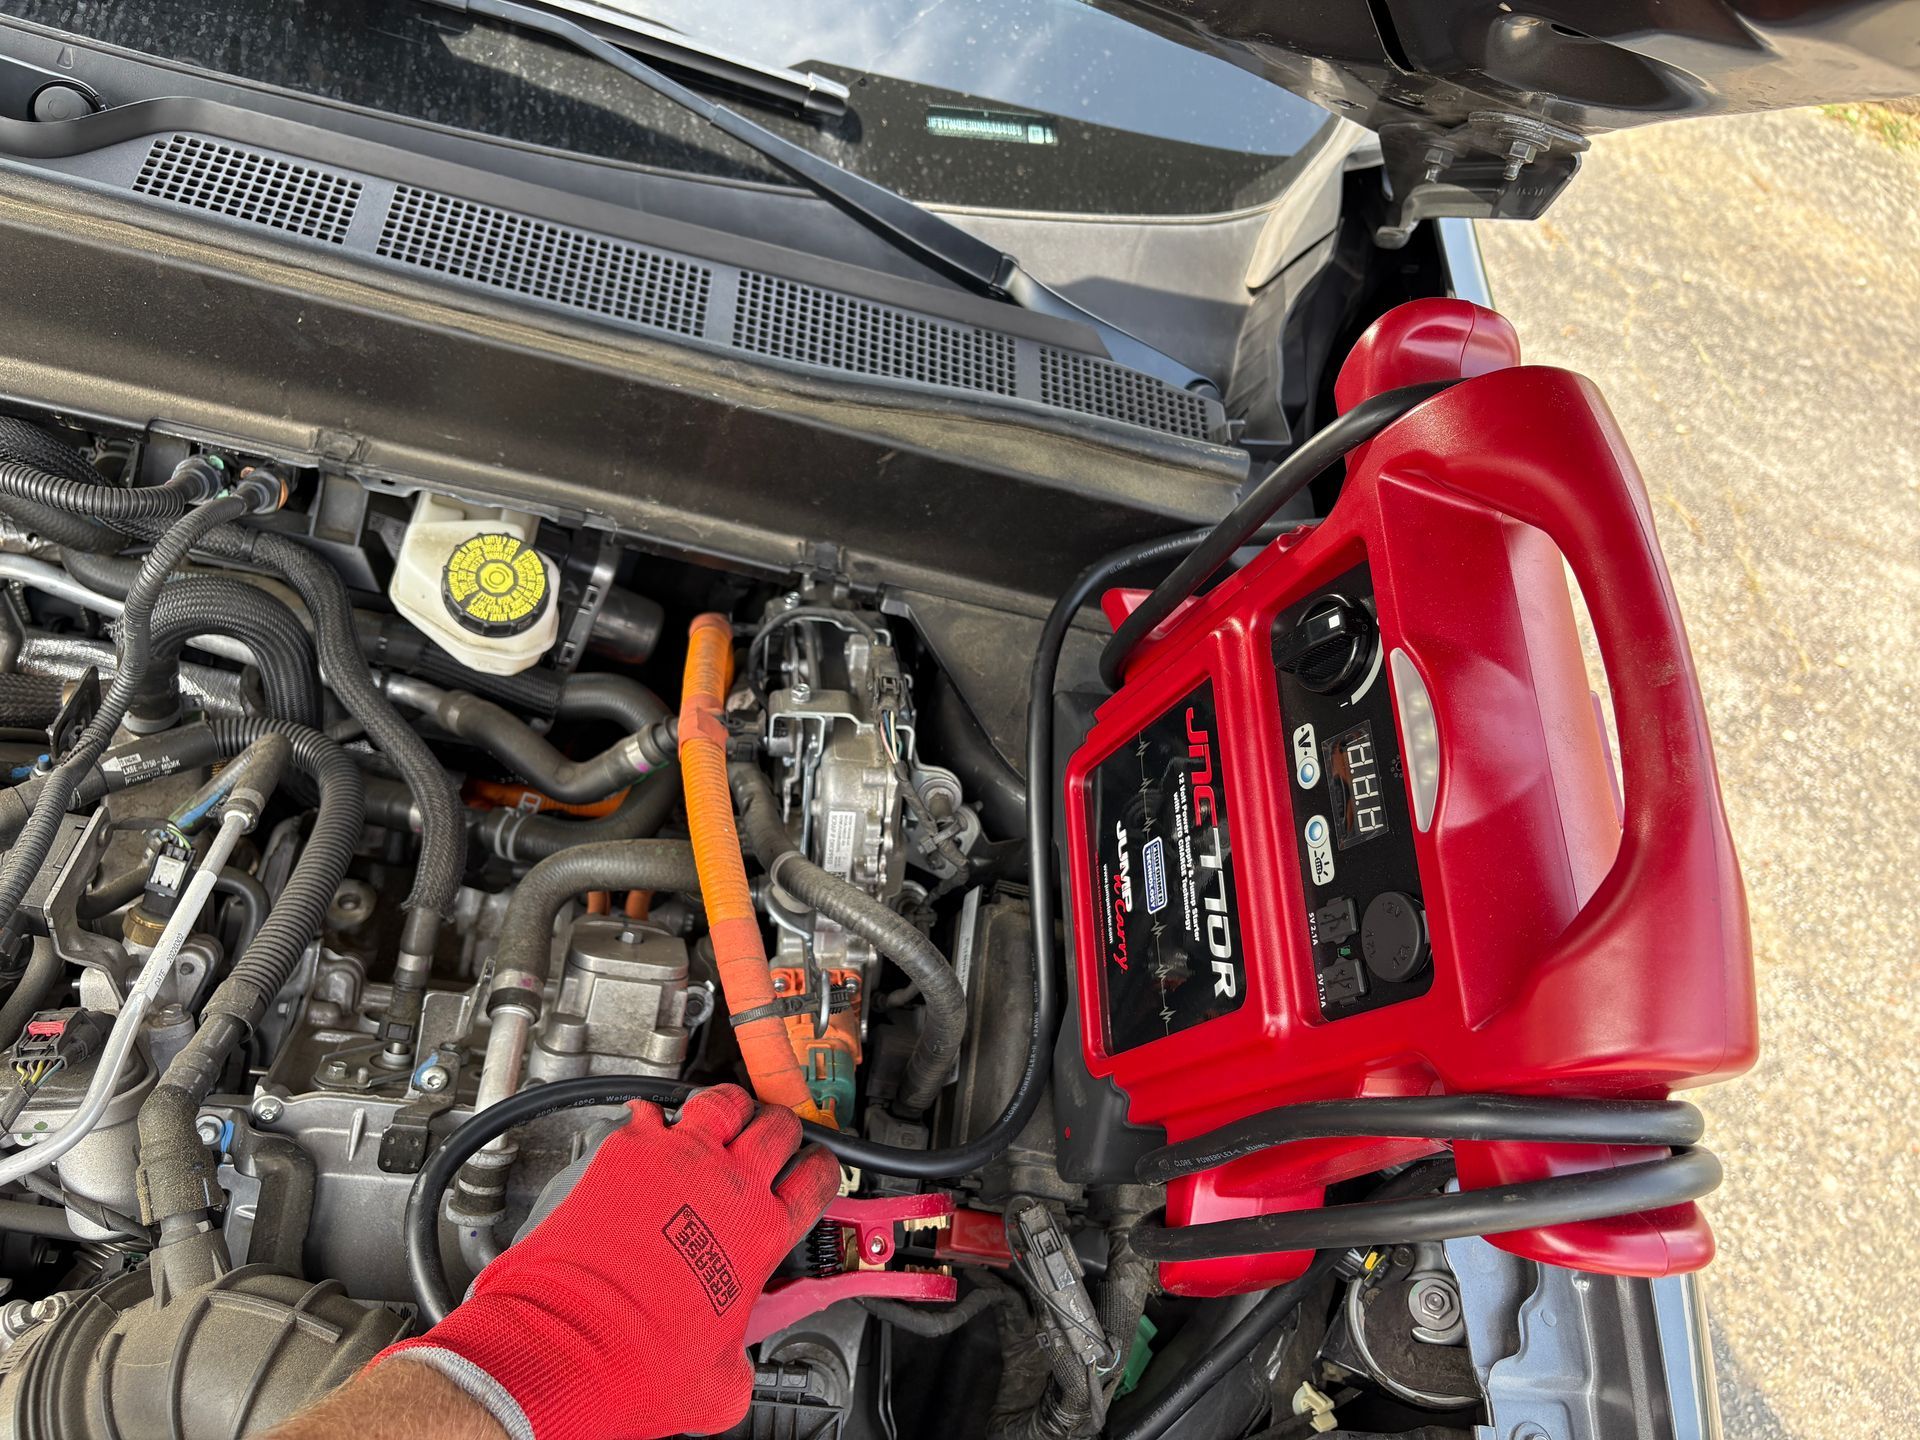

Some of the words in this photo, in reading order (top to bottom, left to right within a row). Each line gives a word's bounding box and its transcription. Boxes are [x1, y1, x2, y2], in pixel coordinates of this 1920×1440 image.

[1177, 772, 1184, 785] 12
[1174, 813, 1182, 838] AUTO
[1180, 804, 1189, 834] Power
[1117, 820, 1132, 912] JUMP
[1177, 840, 1187, 876] CHARGE
[1183, 835, 1193, 867] Supply
[1146, 848, 1156, 908] TECHNOLOGY
[1153, 844, 1164, 903] PROFORMER
[1187, 869, 1193, 877] &
[1180, 878, 1192, 931] Technology
[1188, 879, 1197, 907] Jump
[1115, 898, 1128, 970] Carry
[1191, 908, 1200, 942] Starter
[1308, 912, 1316, 925] 5V
[1310, 926, 1318, 945] 2.1A
[1316, 973, 1324, 986] 5V
[1318, 988, 1327, 1007] 1.1A
[676, 1229, 730, 1307] GREASE
[684, 1219, 739, 1299] MONKEY
